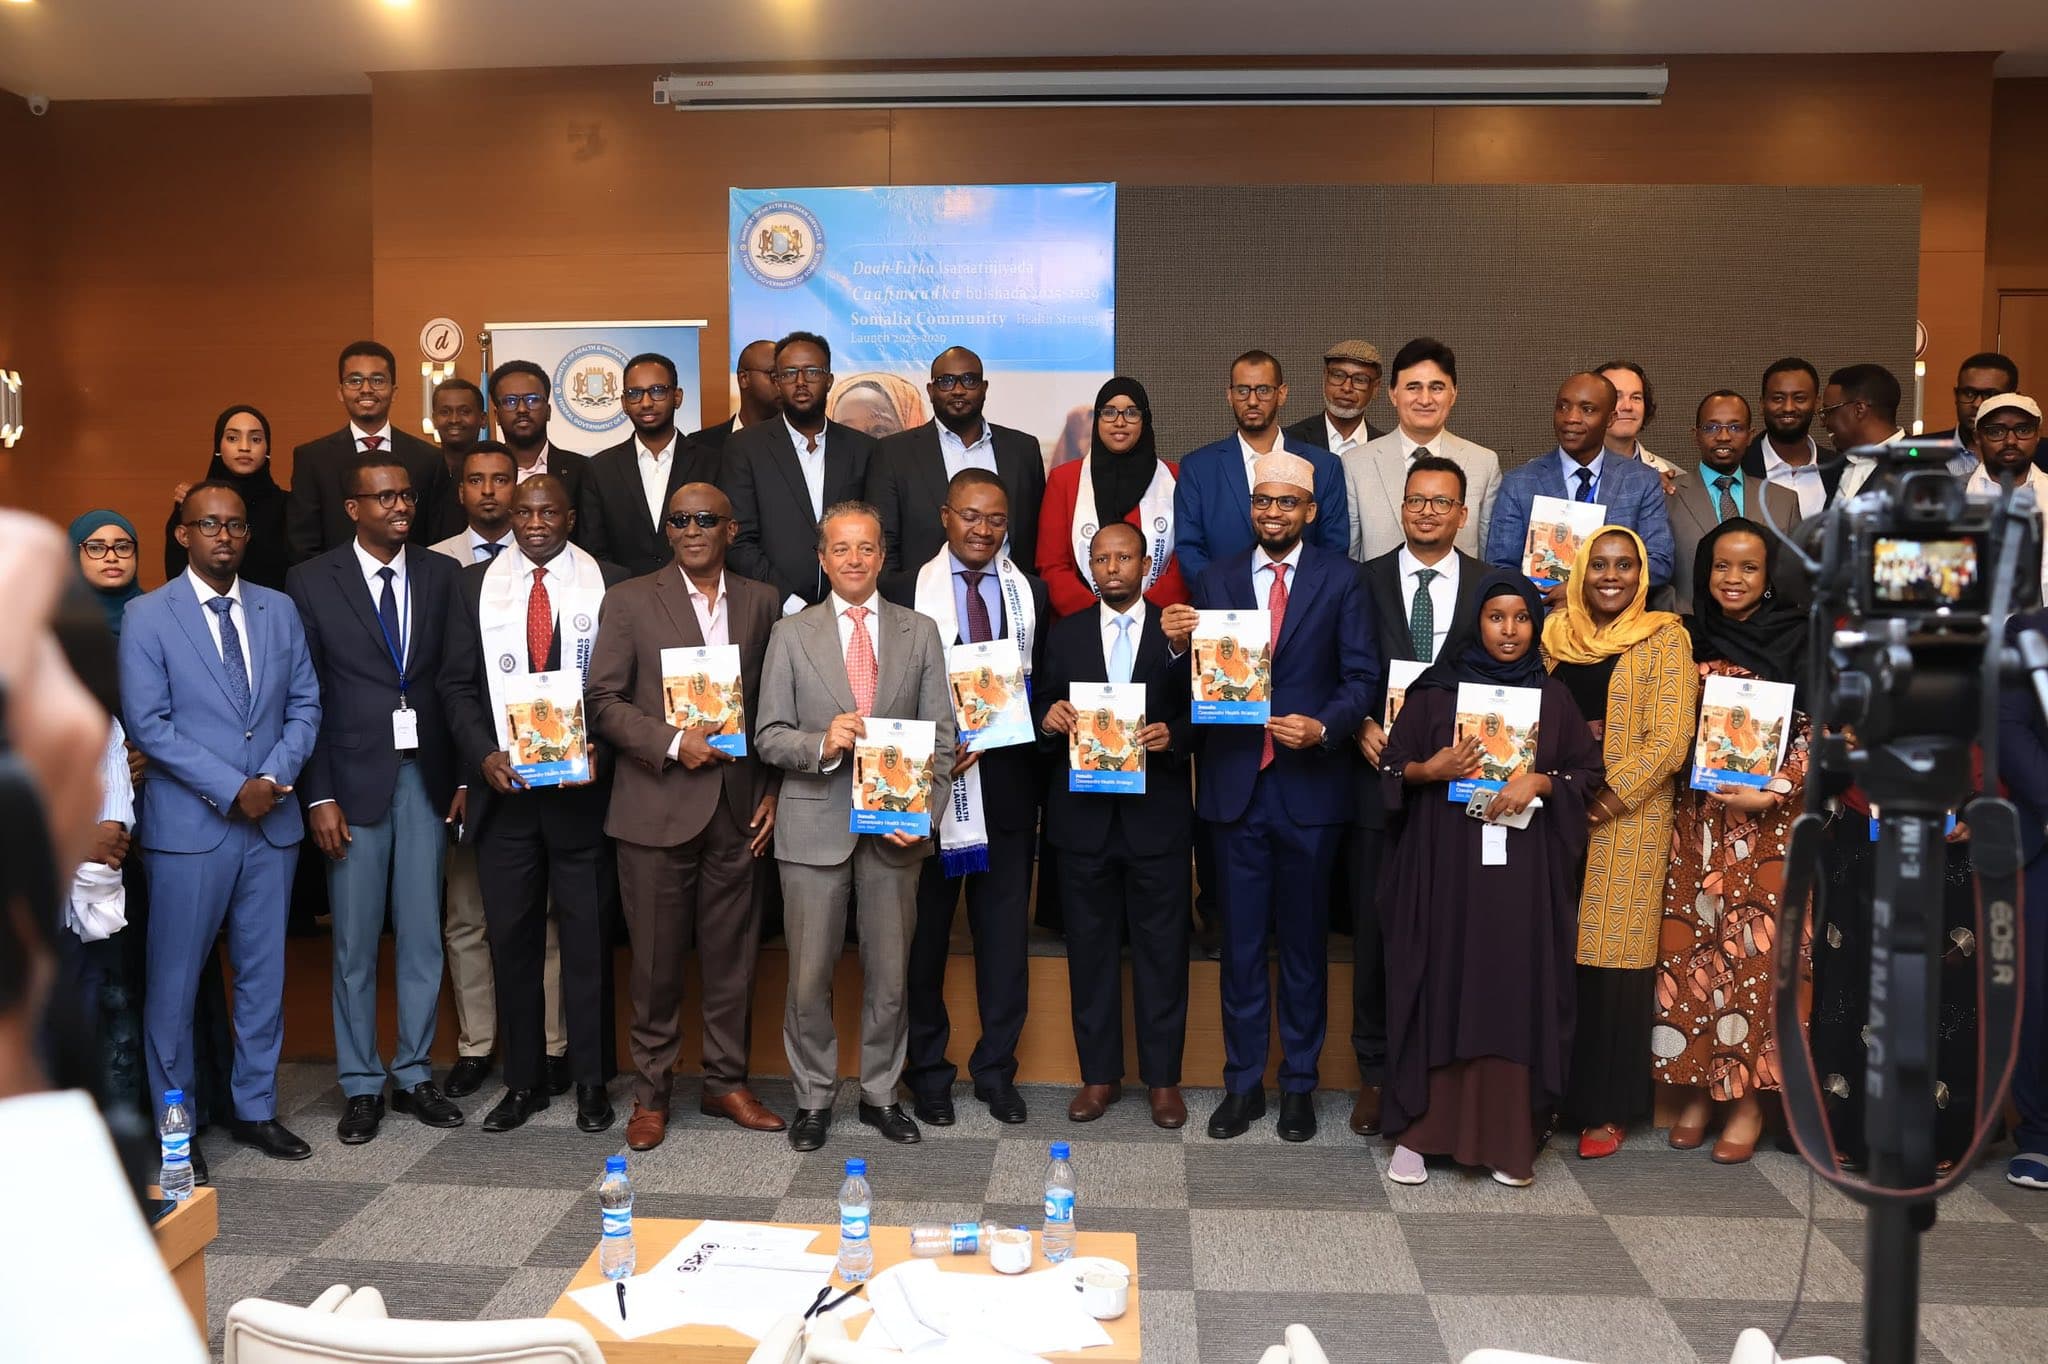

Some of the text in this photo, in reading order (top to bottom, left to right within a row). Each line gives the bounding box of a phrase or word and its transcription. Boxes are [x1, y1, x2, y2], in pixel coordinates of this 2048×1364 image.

[851, 311, 912, 326] Somalia
[916, 311, 1006, 328] Community
[435, 330, 450, 350] d
[850, 332, 890, 344] Launch
[953, 789, 963, 823] LAUNCH
[960, 793, 970, 822] HEALTH
[1990, 901, 2014, 960] EOS
